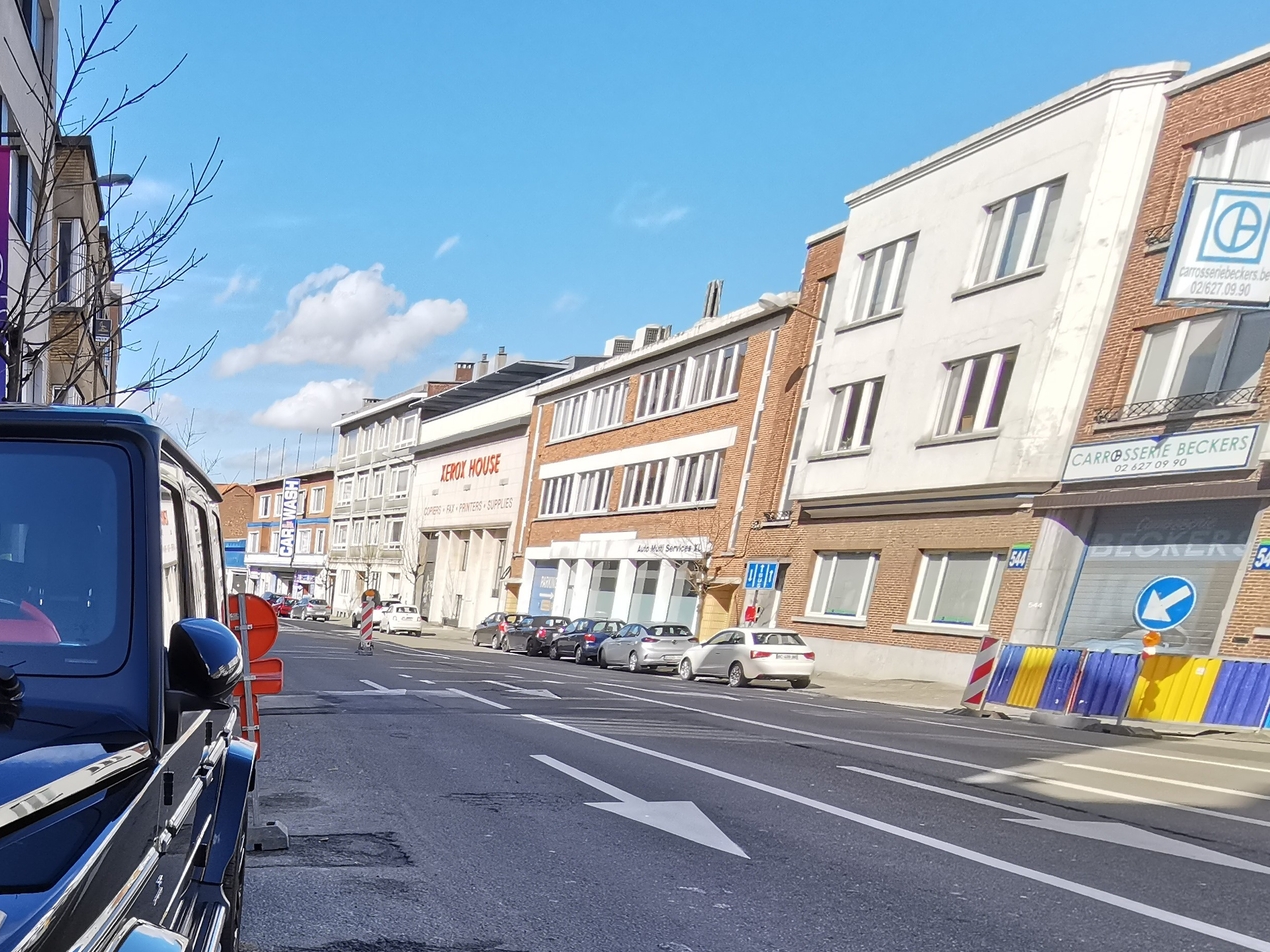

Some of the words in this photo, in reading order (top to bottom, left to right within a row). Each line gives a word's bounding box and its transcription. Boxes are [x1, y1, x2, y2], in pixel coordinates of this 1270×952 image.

[1179, 264, 1270, 281] carrosseriebeckers.be
[1071, 444, 1172, 467] CARROSSERIE
[1176, 435, 1249, 456] BECKERS
[440, 460, 467, 482] XEROX
[468, 453, 502, 478] HOUSE
[1114, 464, 1128, 473] 02
[1130, 462, 1152, 471] 627
[1154, 459, 1170, 469] 09
[1172, 458, 1188, 467] 90
[283, 480, 301, 521] WASH
[423, 505, 442, 516] COPIERS
[446, 503, 455, 514] FAX
[459, 501, 483, 513] PRINTERS
[487, 497, 514, 511] SUPPLIES
[279, 528, 295, 557] CAR
[637, 544, 650, 553] Auto
[665, 544, 692, 553] Services
[1090, 529, 1250, 558] BECKERS
[1008, 550, 1028, 567] 544
[1027, 601, 1043, 609] 544
